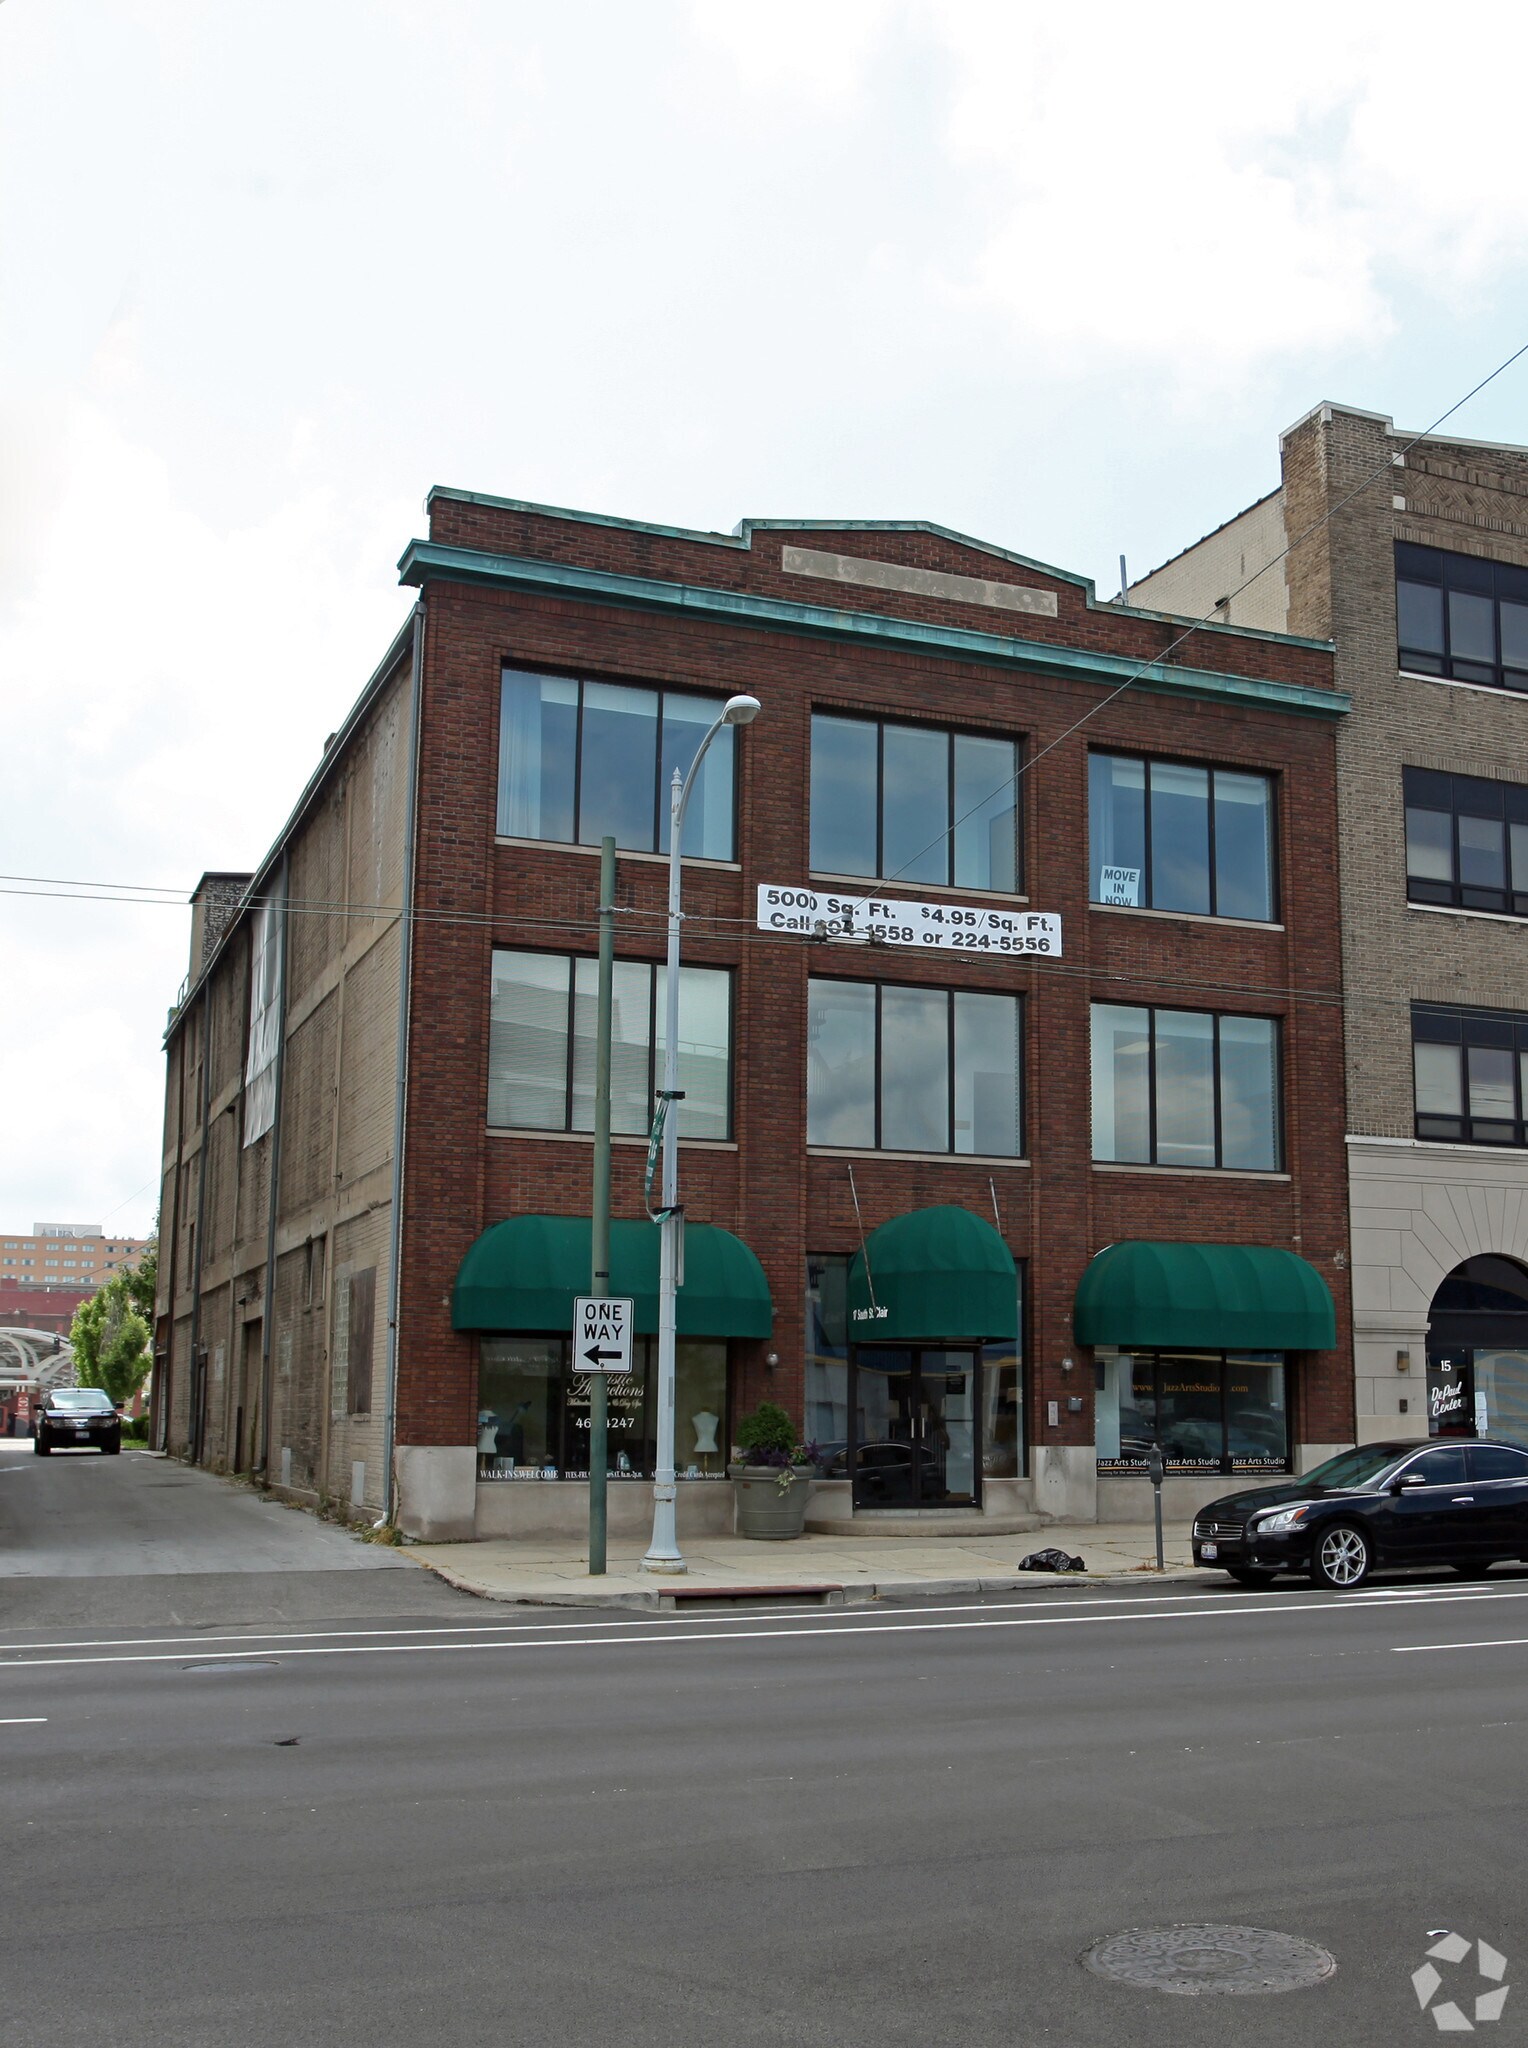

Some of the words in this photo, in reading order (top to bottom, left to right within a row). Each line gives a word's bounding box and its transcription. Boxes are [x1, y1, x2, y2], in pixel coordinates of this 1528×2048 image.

[1104, 869, 1136, 882] MOVE
[1113, 883, 1125, 894] IN
[1105, 895, 1132, 906] NOW
[767, 890, 818, 911] 5000
[869, 903, 896, 919] Ft.
[921, 907, 1018, 933] $4.95/Sq.
[1027, 917, 1054, 932] Ft.
[770, 912, 809, 930] Call
[922, 933, 943, 945] or
[951, 932, 1051, 952] 224-5556
[585, 1303, 622, 1321] ONE
[584, 1323, 624, 1341] WAY
[1440, 1360, 1452, 1372] 15
[1162, 1382, 1220, 1394] JazzArtsStudio
[1432, 1398, 1462, 1416] Center
[575, 1417, 635, 1428] 464247
[1097, 1458, 1112, 1466] Jazz
[1114, 1458, 1129, 1466] Arts
[1165, 1458, 1180, 1466] Jazz
[1181, 1458, 1196, 1466] Arts
[1248, 1457, 1262, 1465] Arts
[1263, 1457, 1285, 1465] Studio
[518, 1470, 558, 1479] WELCOME
